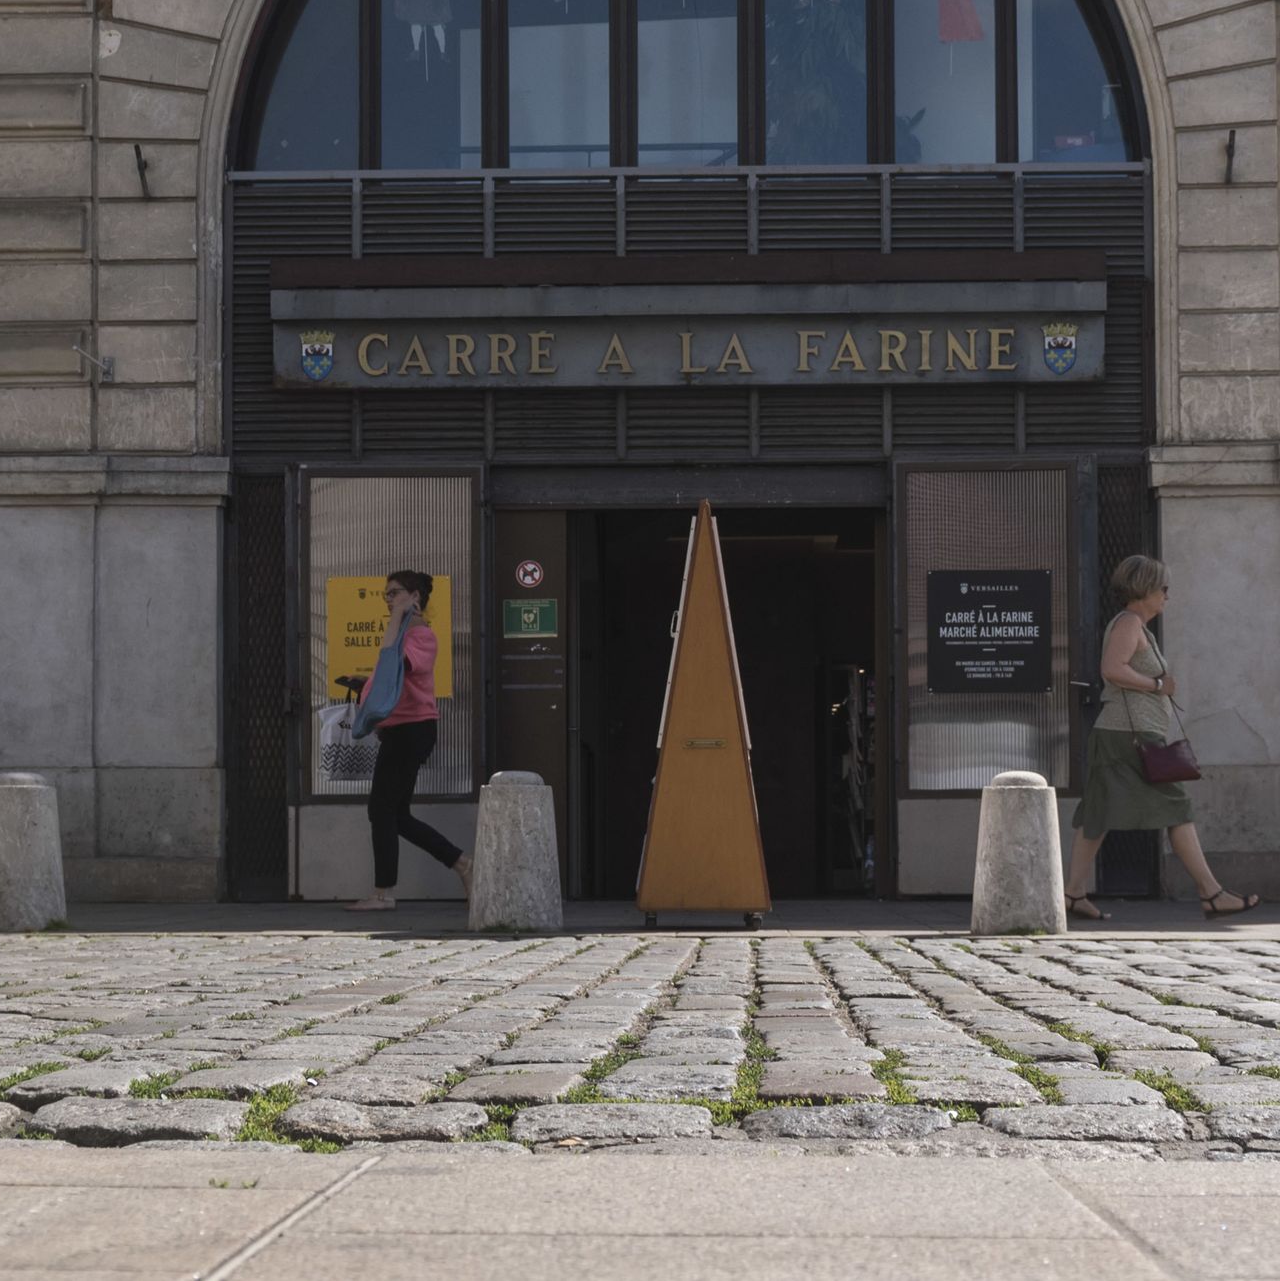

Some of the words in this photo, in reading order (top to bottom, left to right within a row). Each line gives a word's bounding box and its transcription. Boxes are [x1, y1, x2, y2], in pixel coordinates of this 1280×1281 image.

[356, 330, 560, 377] CARRÉ
[678, 331, 755, 375] LA
[795, 328, 1018, 374] FARINE
[945, 609, 976, 623] CARRÉ
[978, 609, 984, 623] À
[987, 612, 998, 623] LA
[1001, 611, 1034, 623] FARINE
[347, 620, 376, 633] CARRÉ
[939, 624, 978, 638] MARCHÉ
[979, 625, 1040, 638] ALIMENTAIRE
[344, 636, 372, 647] SALLE
